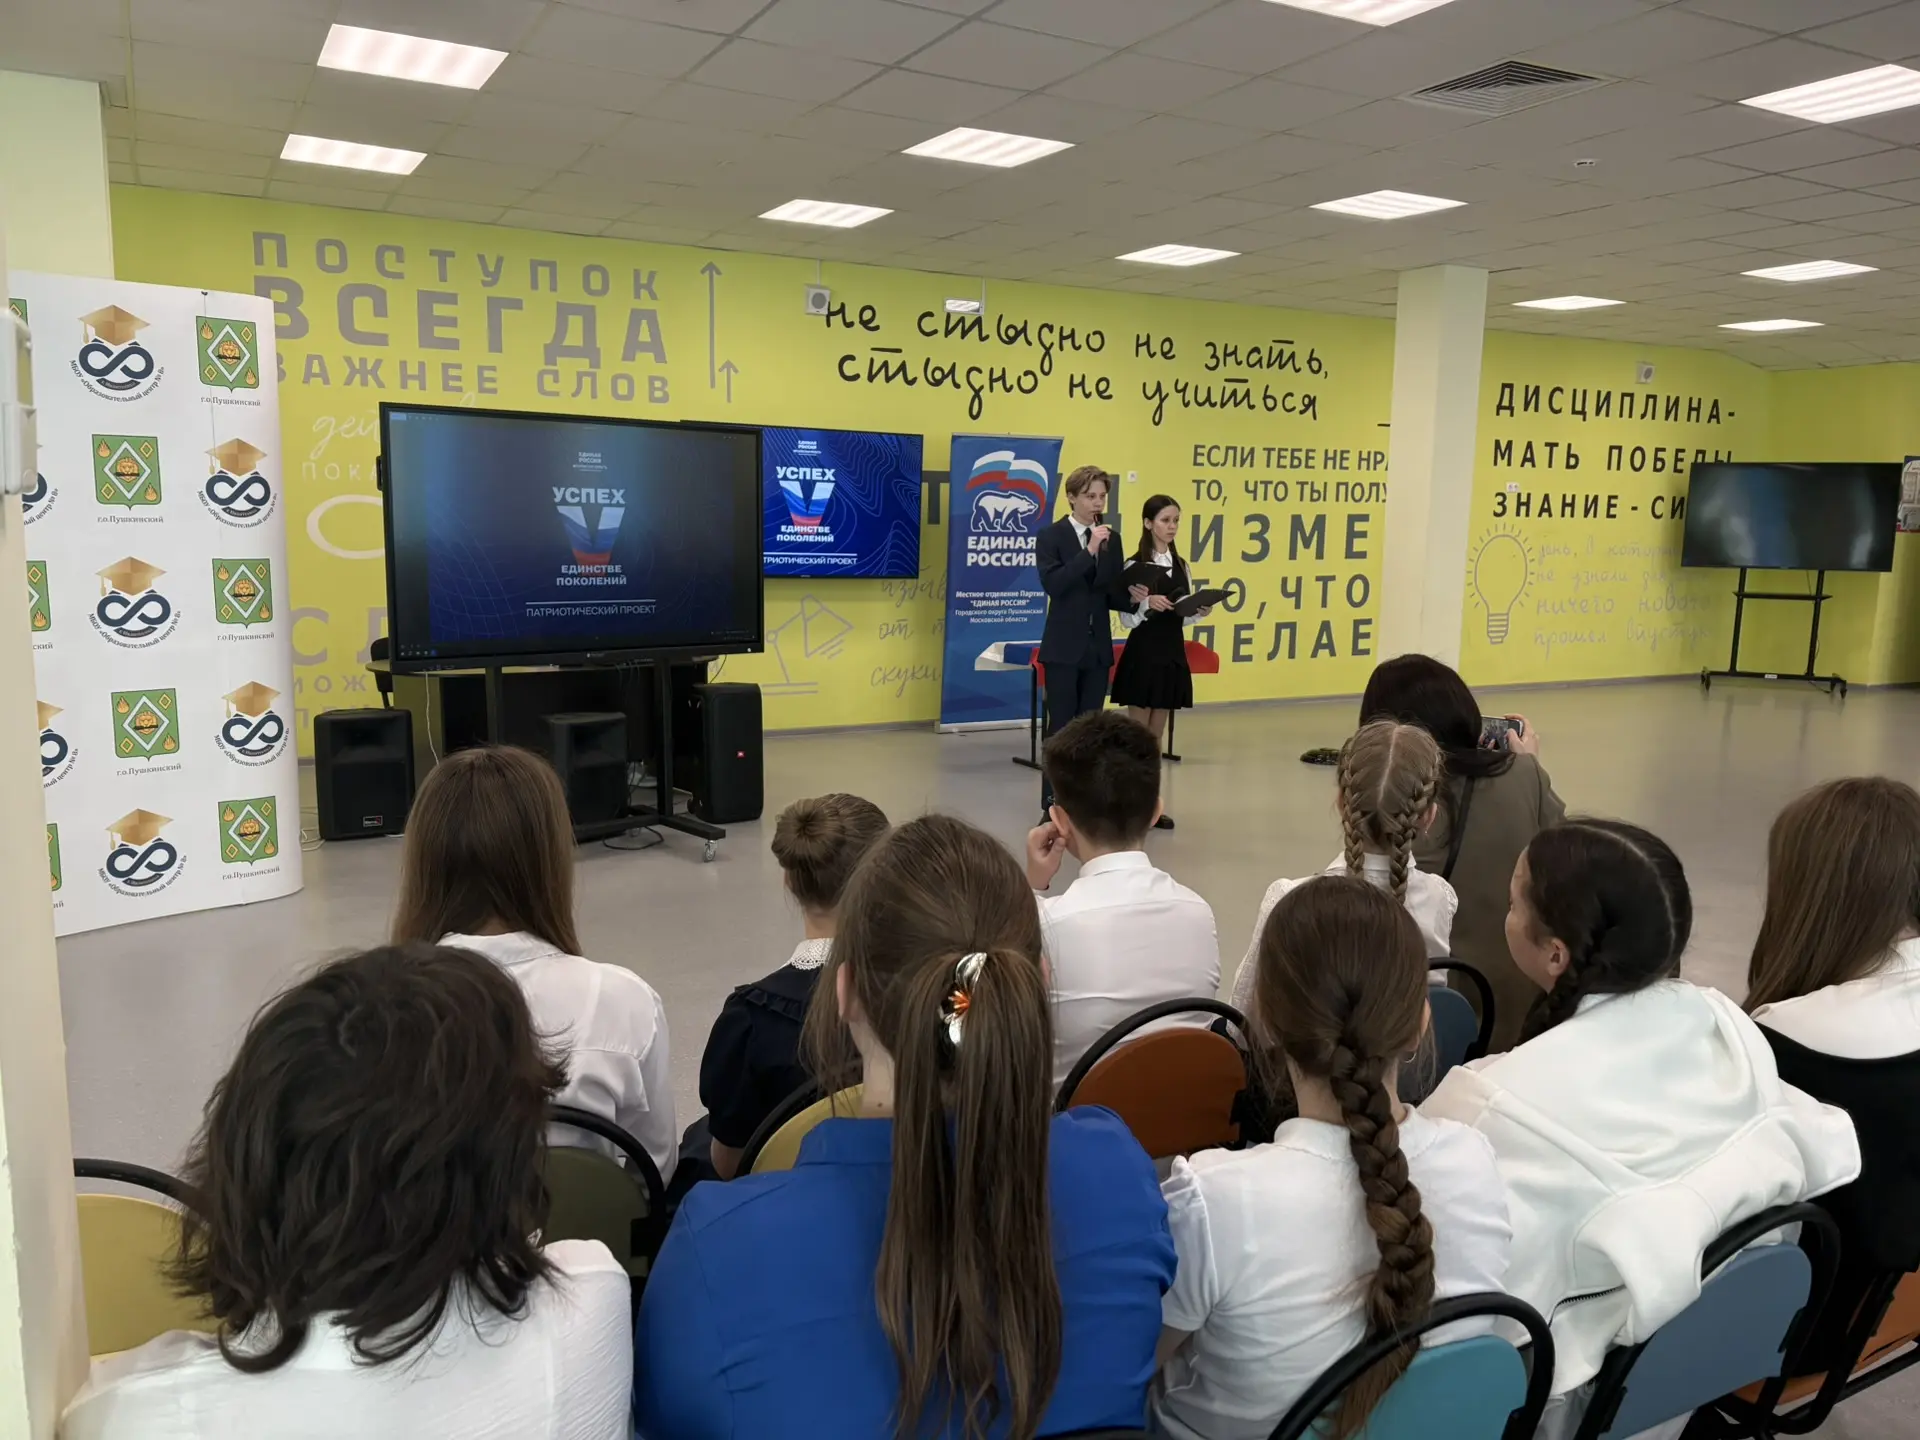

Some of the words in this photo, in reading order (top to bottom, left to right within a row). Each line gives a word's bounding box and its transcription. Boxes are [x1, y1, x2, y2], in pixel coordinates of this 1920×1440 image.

[252, 232, 660, 301] ПОСТУПОК
[253, 274, 667, 369] ВСЕГДА
[825, 301, 881, 332] не
[917, 310, 1105, 376] стыдно
[1135, 333, 1176, 361] не
[1204, 339, 1329, 380] знать,
[536, 369, 671, 405] СЛОВ
[837, 347, 1039, 421] стыдно
[1068, 373, 1114, 400] не
[1142, 378, 1318, 427] учиться
[1192, 444, 1255, 468] ЕСЛИ
[1263, 447, 1316, 470] ТЕБЕ
[1323, 449, 1350, 471] НЕ
[1493, 439, 1580, 471] МАТЬ
[776, 466, 836, 481] УСПЕХ
[552, 486, 626, 504] УСПЕХ
[1192, 479, 1229, 507] ТО,
[1244, 480, 1289, 502] ЧТО
[1296, 481, 1327, 502] ТЫ
[1493, 492, 1619, 519] ЗНАНИЕ
[776, 533, 834, 543] ПОКОЛЕНИЙ
[781, 525, 831, 534] ЕДИНСТВЕ
[1190, 513, 1370, 563] ИЗМЕ
[967, 536, 1037, 551] ЕДИНАЯ
[561, 564, 622, 575] ЕДИНСТВЕ
[827, 557, 858, 565] ПРОЕКТ
[967, 552, 1037, 566] РОССИЯ
[556, 575, 627, 586] ПОКОЛЕНИЙ
[1280, 574, 1371, 609] ЧТО
[526, 605, 619, 617] ПАТРИОТИЧЕСКИЙ
[620, 604, 657, 615] ПРОЕКТ
